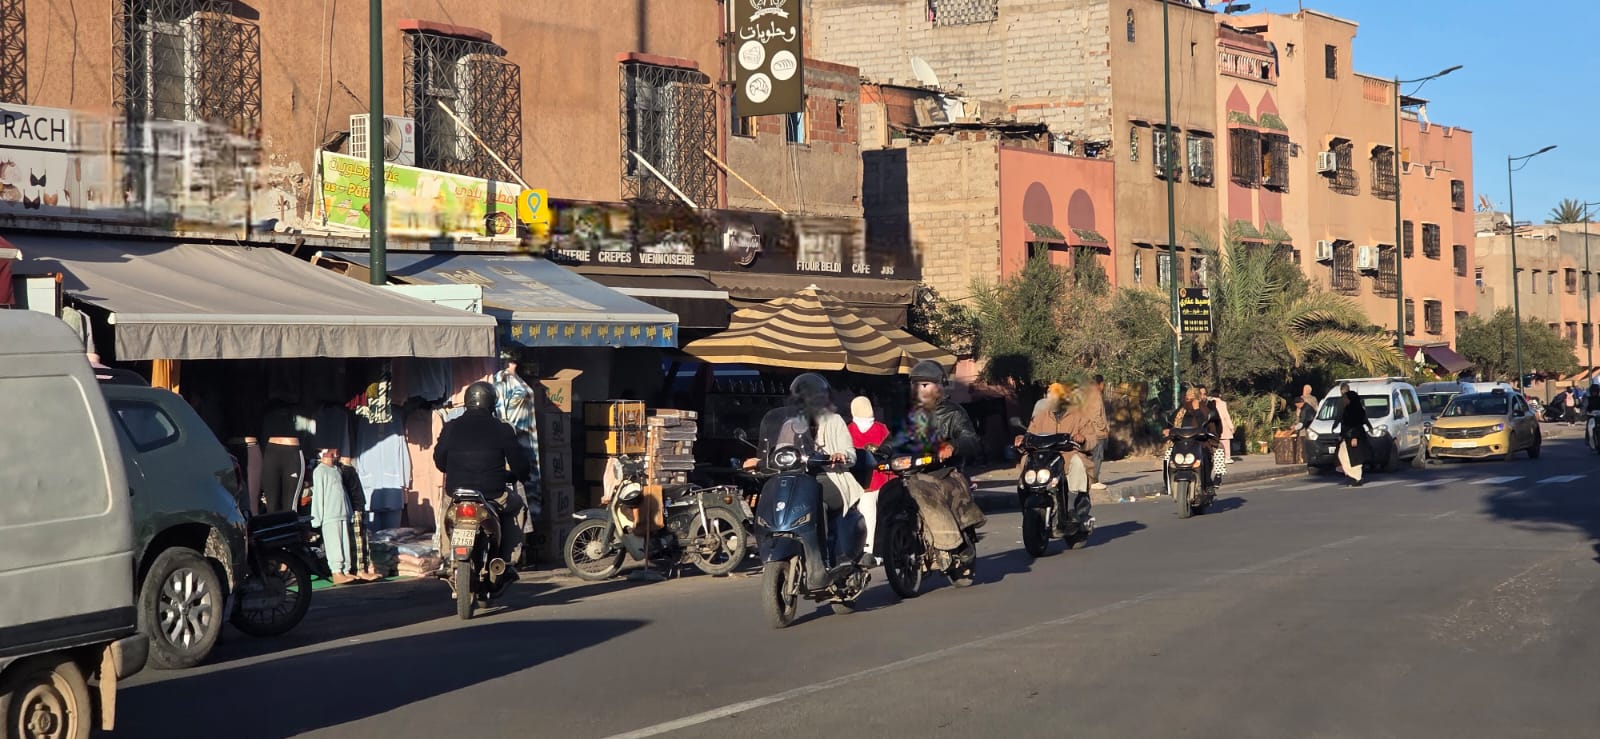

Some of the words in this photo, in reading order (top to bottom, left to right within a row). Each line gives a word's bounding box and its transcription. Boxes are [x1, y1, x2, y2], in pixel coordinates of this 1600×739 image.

[739, 21, 797, 44] وحلويات
[4, 114, 65, 142] RACH
[598, 251, 632, 263] CREPES
[639, 252, 696, 266] VIENNOISERIE
[796, 260, 820, 272] FTOUR
[821, 261, 842, 273] BELDI
[852, 263, 871, 274] CAFE
[880, 265, 895, 275] JUS
